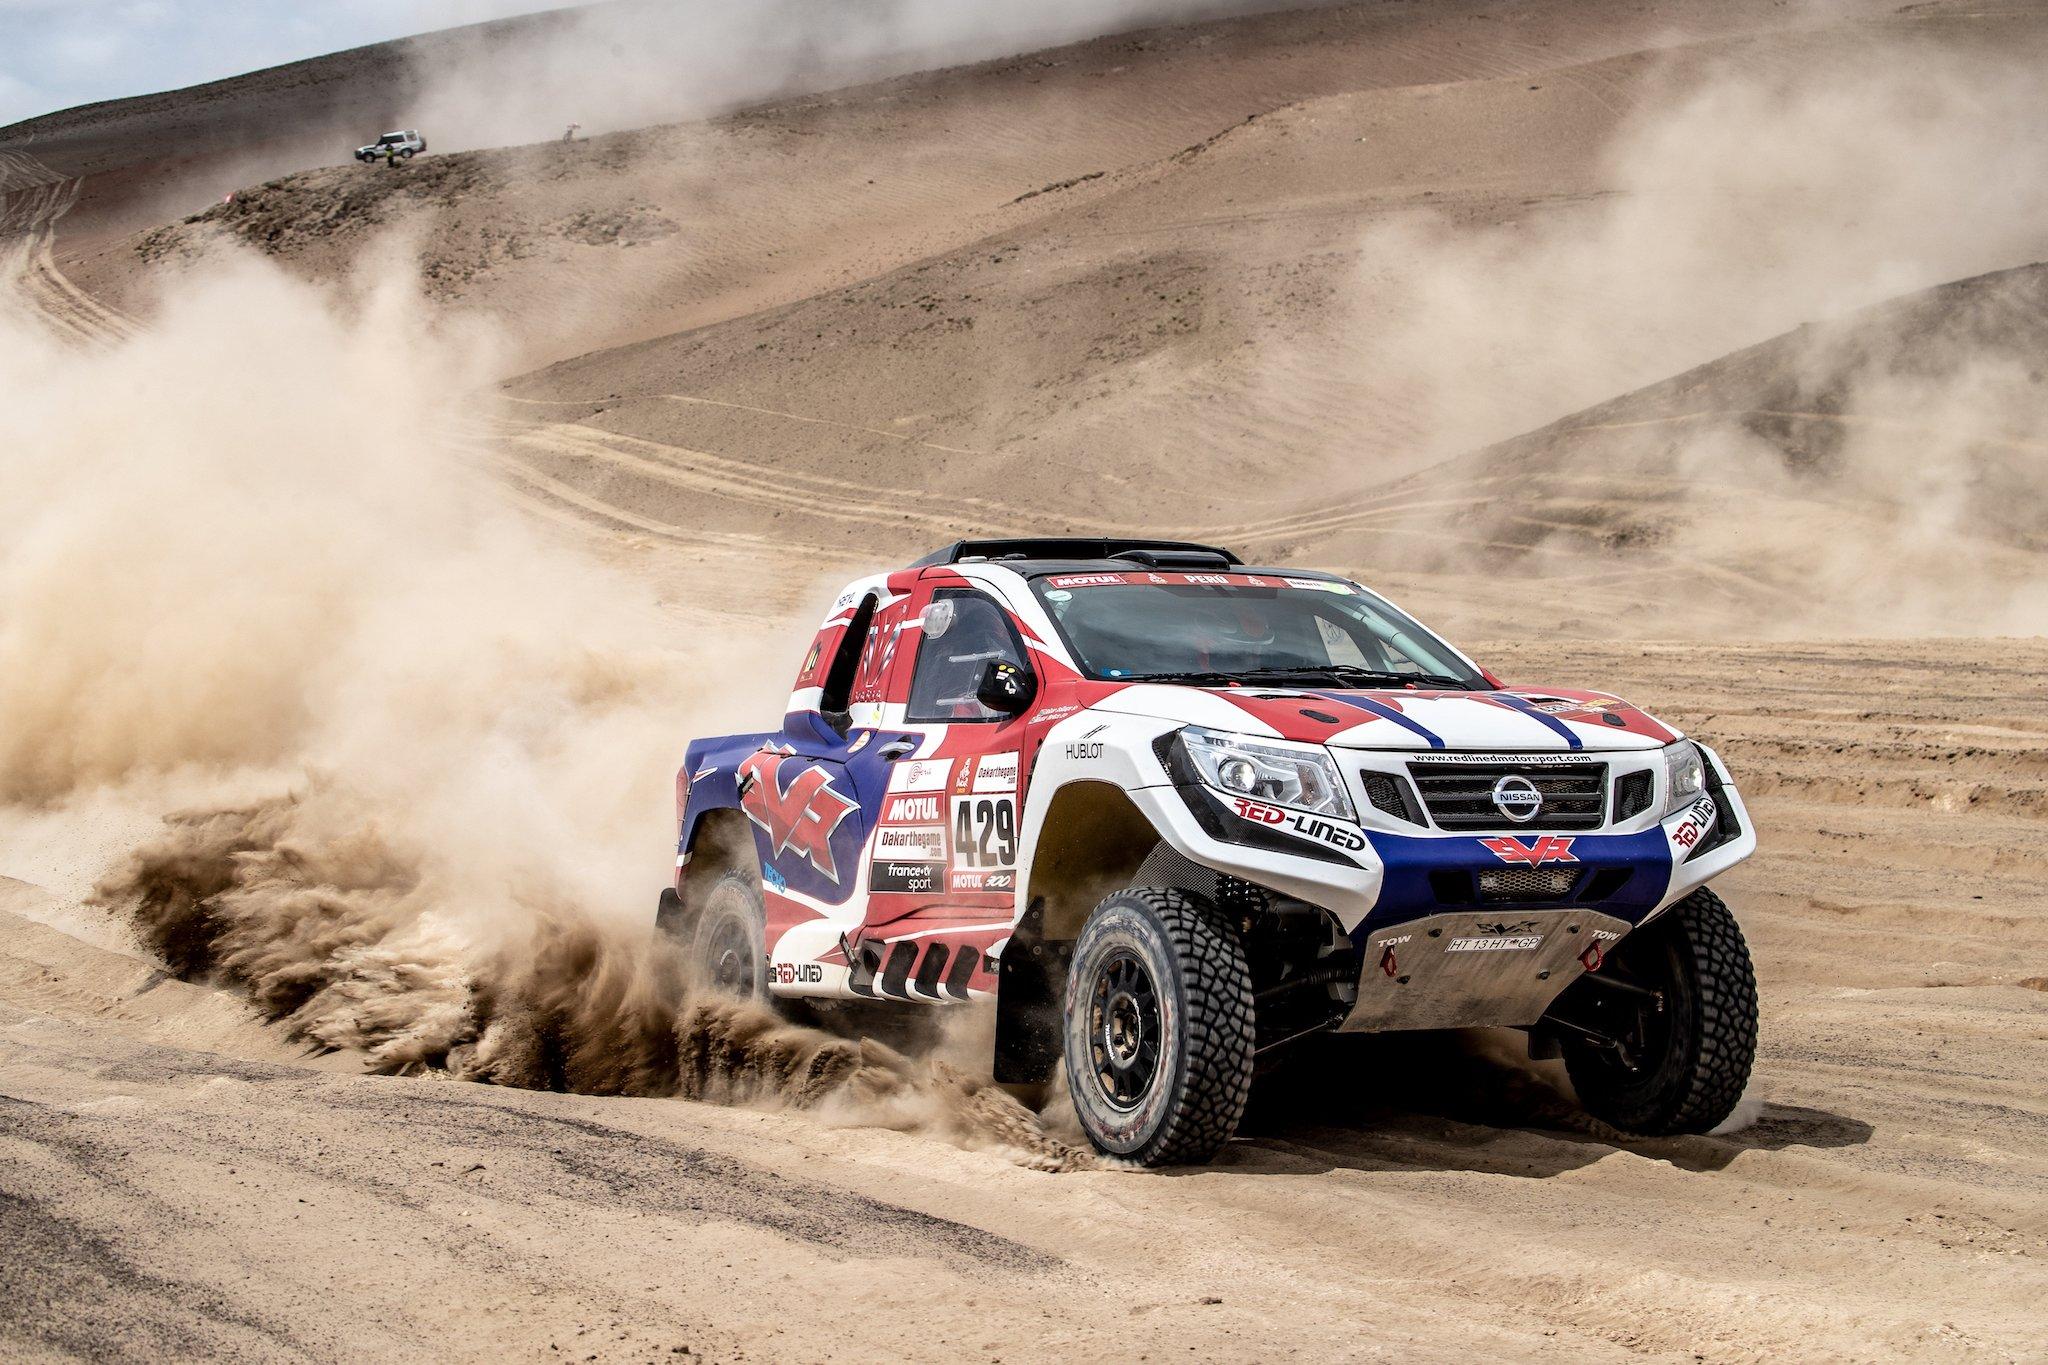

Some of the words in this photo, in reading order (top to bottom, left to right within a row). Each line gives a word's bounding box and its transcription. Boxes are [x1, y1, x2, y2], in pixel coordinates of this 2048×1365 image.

[1056, 575, 1121, 586] MOTUL
[1066, 743, 1104, 759] HUBLOT
[1413, 754, 1592, 764] www.redlinedmotorsport.com
[978, 765, 1017, 779] Dakarthegame
[1500, 793, 1540, 801] NISSAN
[888, 796, 939, 821] MOTUL
[1234, 798, 1366, 851] RED-LINED
[1671, 797, 1715, 848] RED-LINED
[881, 830, 942, 849] Dakarthegame
[955, 799, 1016, 867] 429
[908, 877, 932, 892] sport
[953, 874, 982, 888] MOTUL
[1378, 934, 1412, 947] TOW
[1592, 929, 1620, 940] TOW
[1450, 940, 1470, 949] HT
[1474, 940, 1488, 949] 13
[1490, 939, 1510, 949] HT
[1517, 938, 1539, 948] GP
[777, 963, 823, 984] RED-LINED
